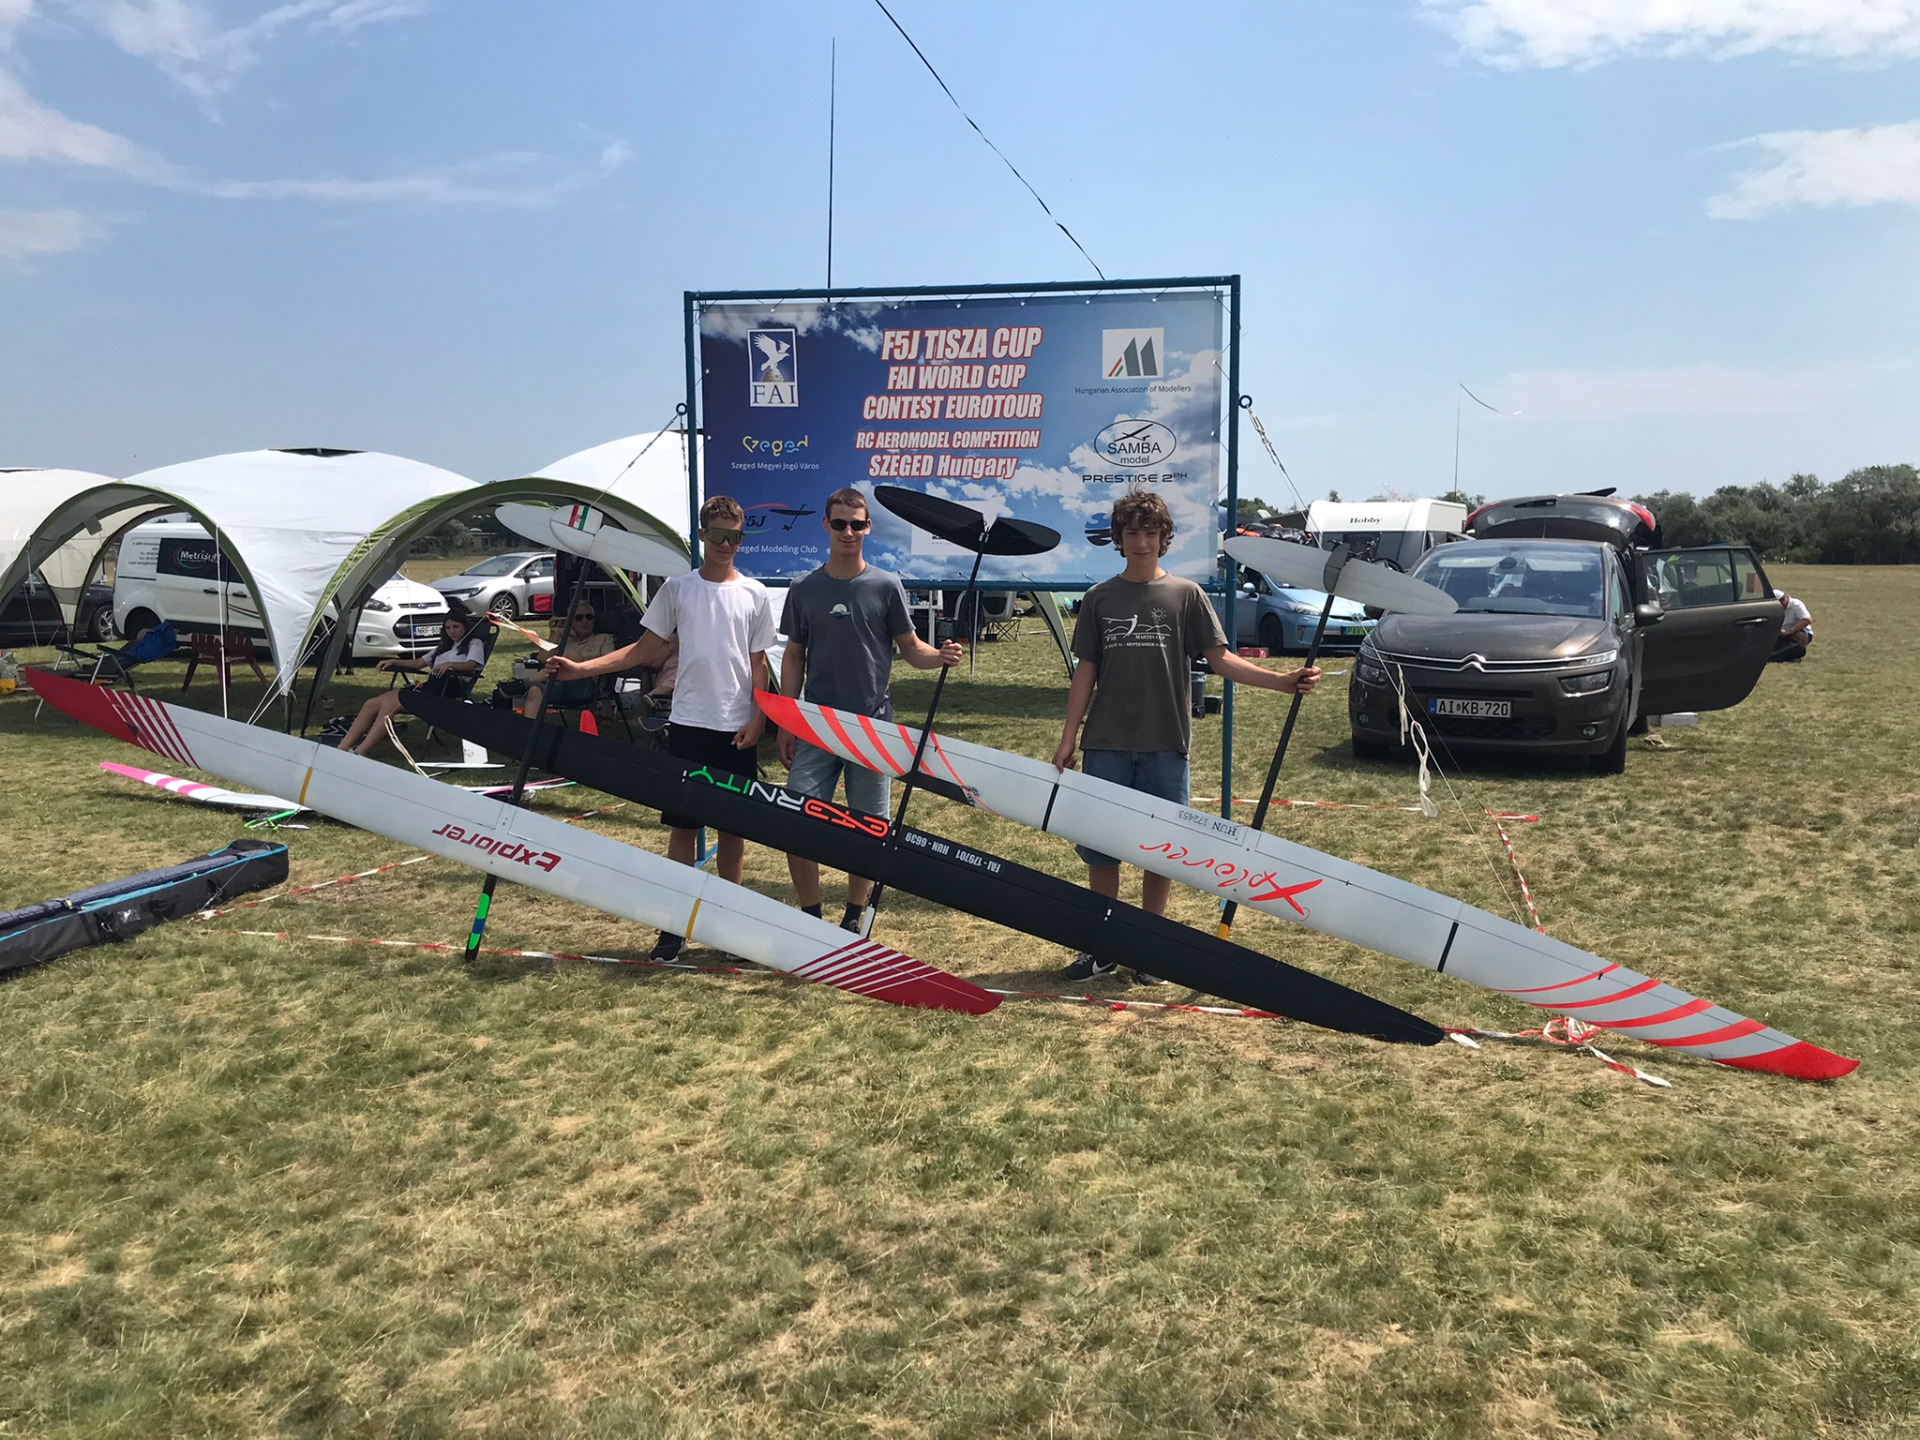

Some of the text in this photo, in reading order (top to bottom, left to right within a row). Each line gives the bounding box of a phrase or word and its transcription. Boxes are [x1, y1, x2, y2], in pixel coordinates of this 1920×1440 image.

[881, 326, 1043, 361] F5J TISZA CUP
[887, 363, 1027, 390] FAI WORLD CUP
[752, 384, 797, 404] FAI
[1075, 387, 1109, 395] Hungarian
[1110, 386, 1148, 394] Association
[1158, 385, 1192, 393] Modellers
[862, 393, 1043, 420] CONTEST EUROTOUR
[855, 430, 1041, 449] RC AEROMODEL COMPETITION
[1107, 442, 1162, 455] SAMBA
[731, 462, 819, 471] Szeged Megyei Jogú Város
[868, 453, 1018, 480] SZEGED Hungary
[1120, 455, 1150, 464] model
[1082, 474, 1158, 483] PRESTIGE
[736, 545, 818, 555] zeged Modelling Club
[1178, 810, 1237, 837] HUN 172453
[905, 832, 928, 847] 6639
[432, 823, 562, 873] Explorer
[931, 841, 950, 855] HUN
[955, 849, 982, 867] 179701
[986, 860, 1001, 873] FAI
